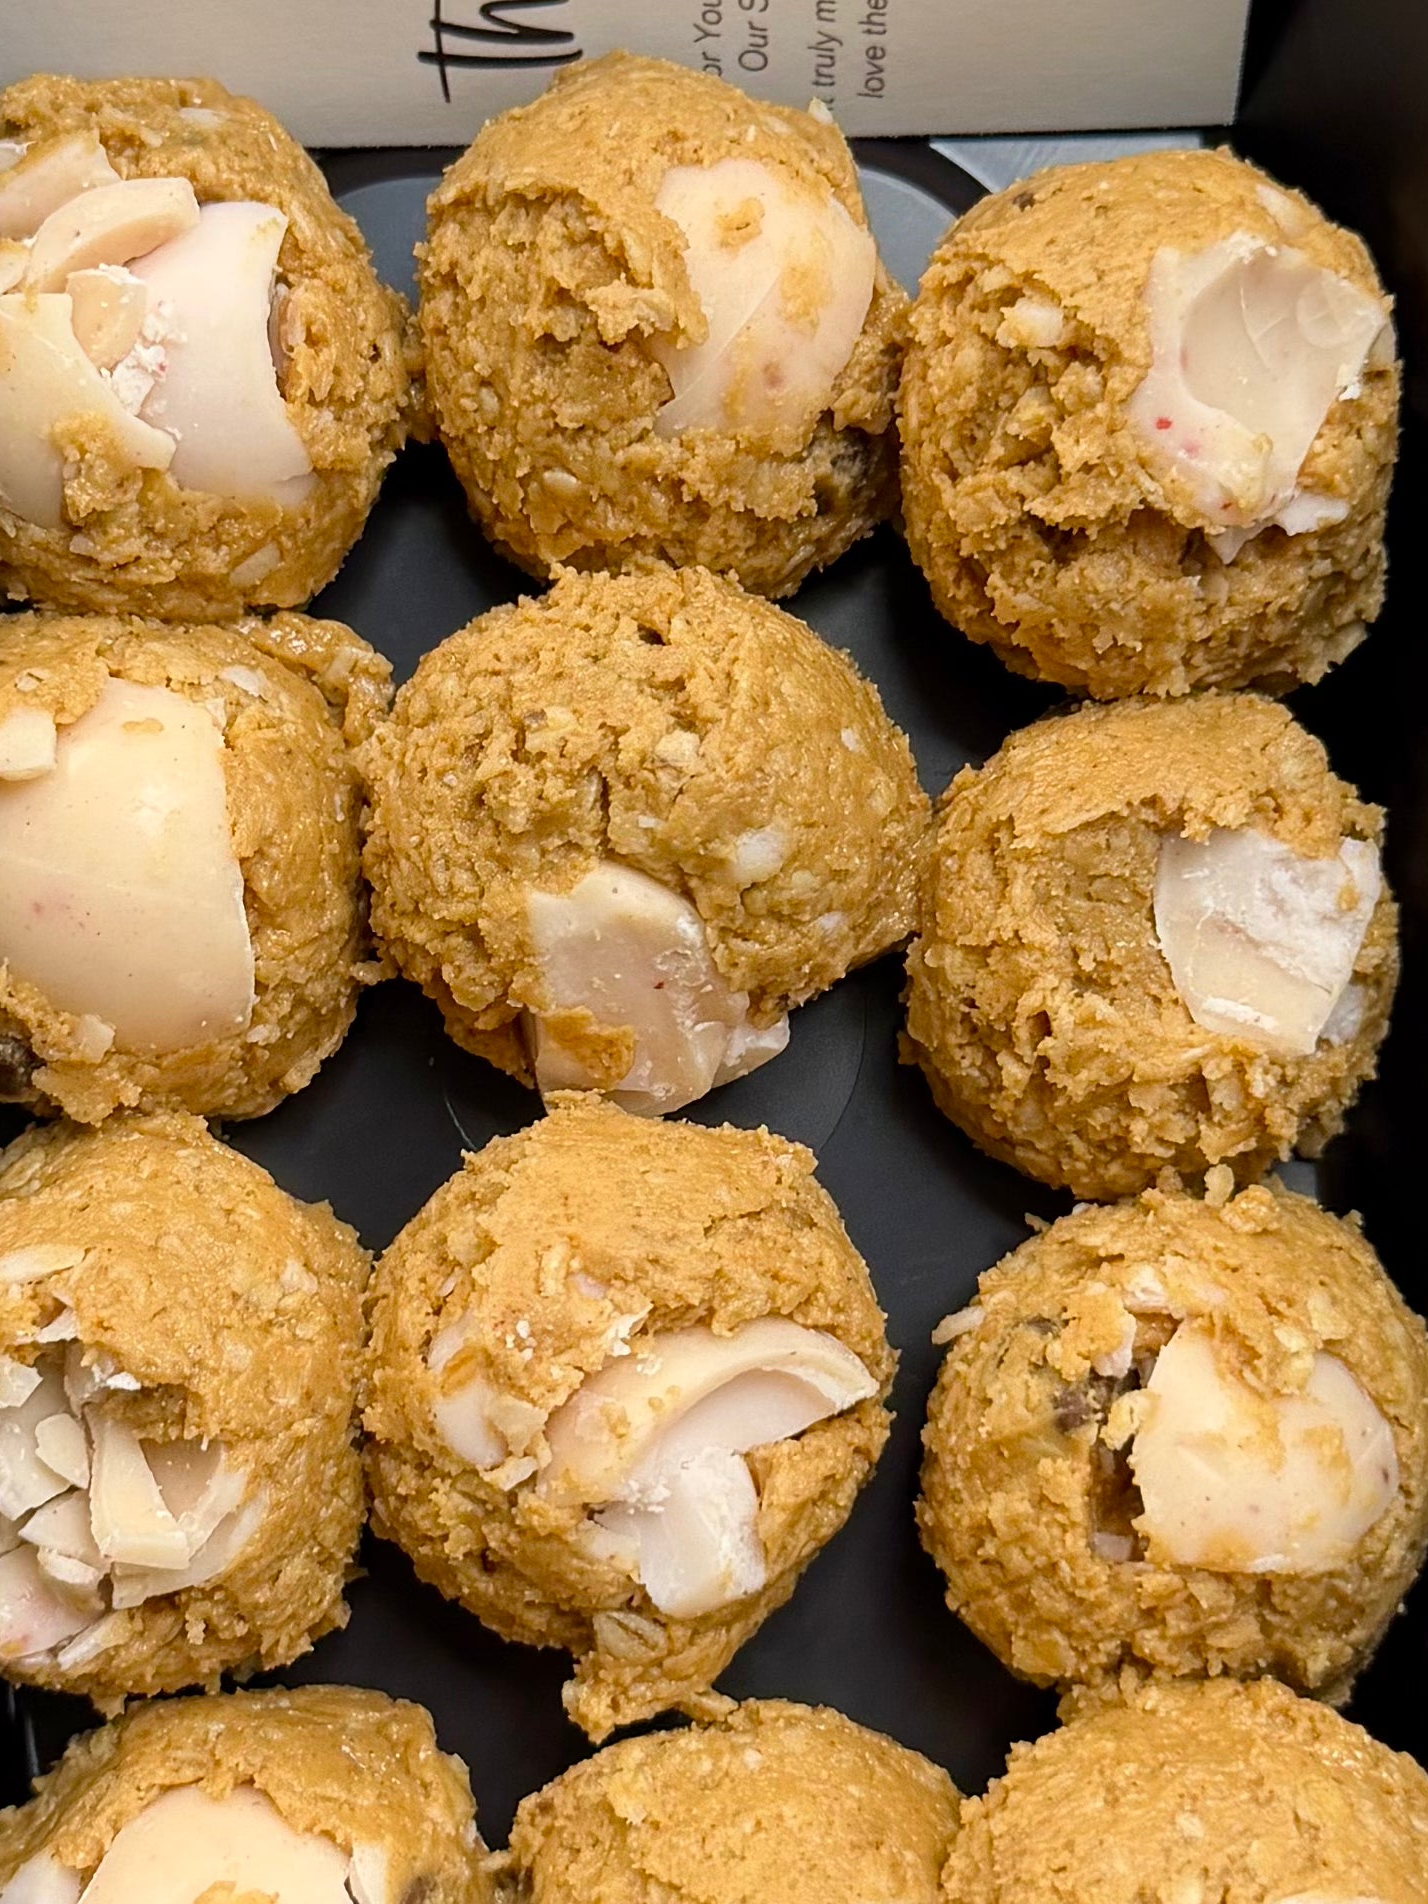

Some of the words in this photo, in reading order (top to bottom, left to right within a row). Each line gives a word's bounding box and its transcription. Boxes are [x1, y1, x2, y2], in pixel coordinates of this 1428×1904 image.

[738, 21, 769, 72] Our
[807, 30, 843, 87] truly
[857, 45, 887, 99] love
